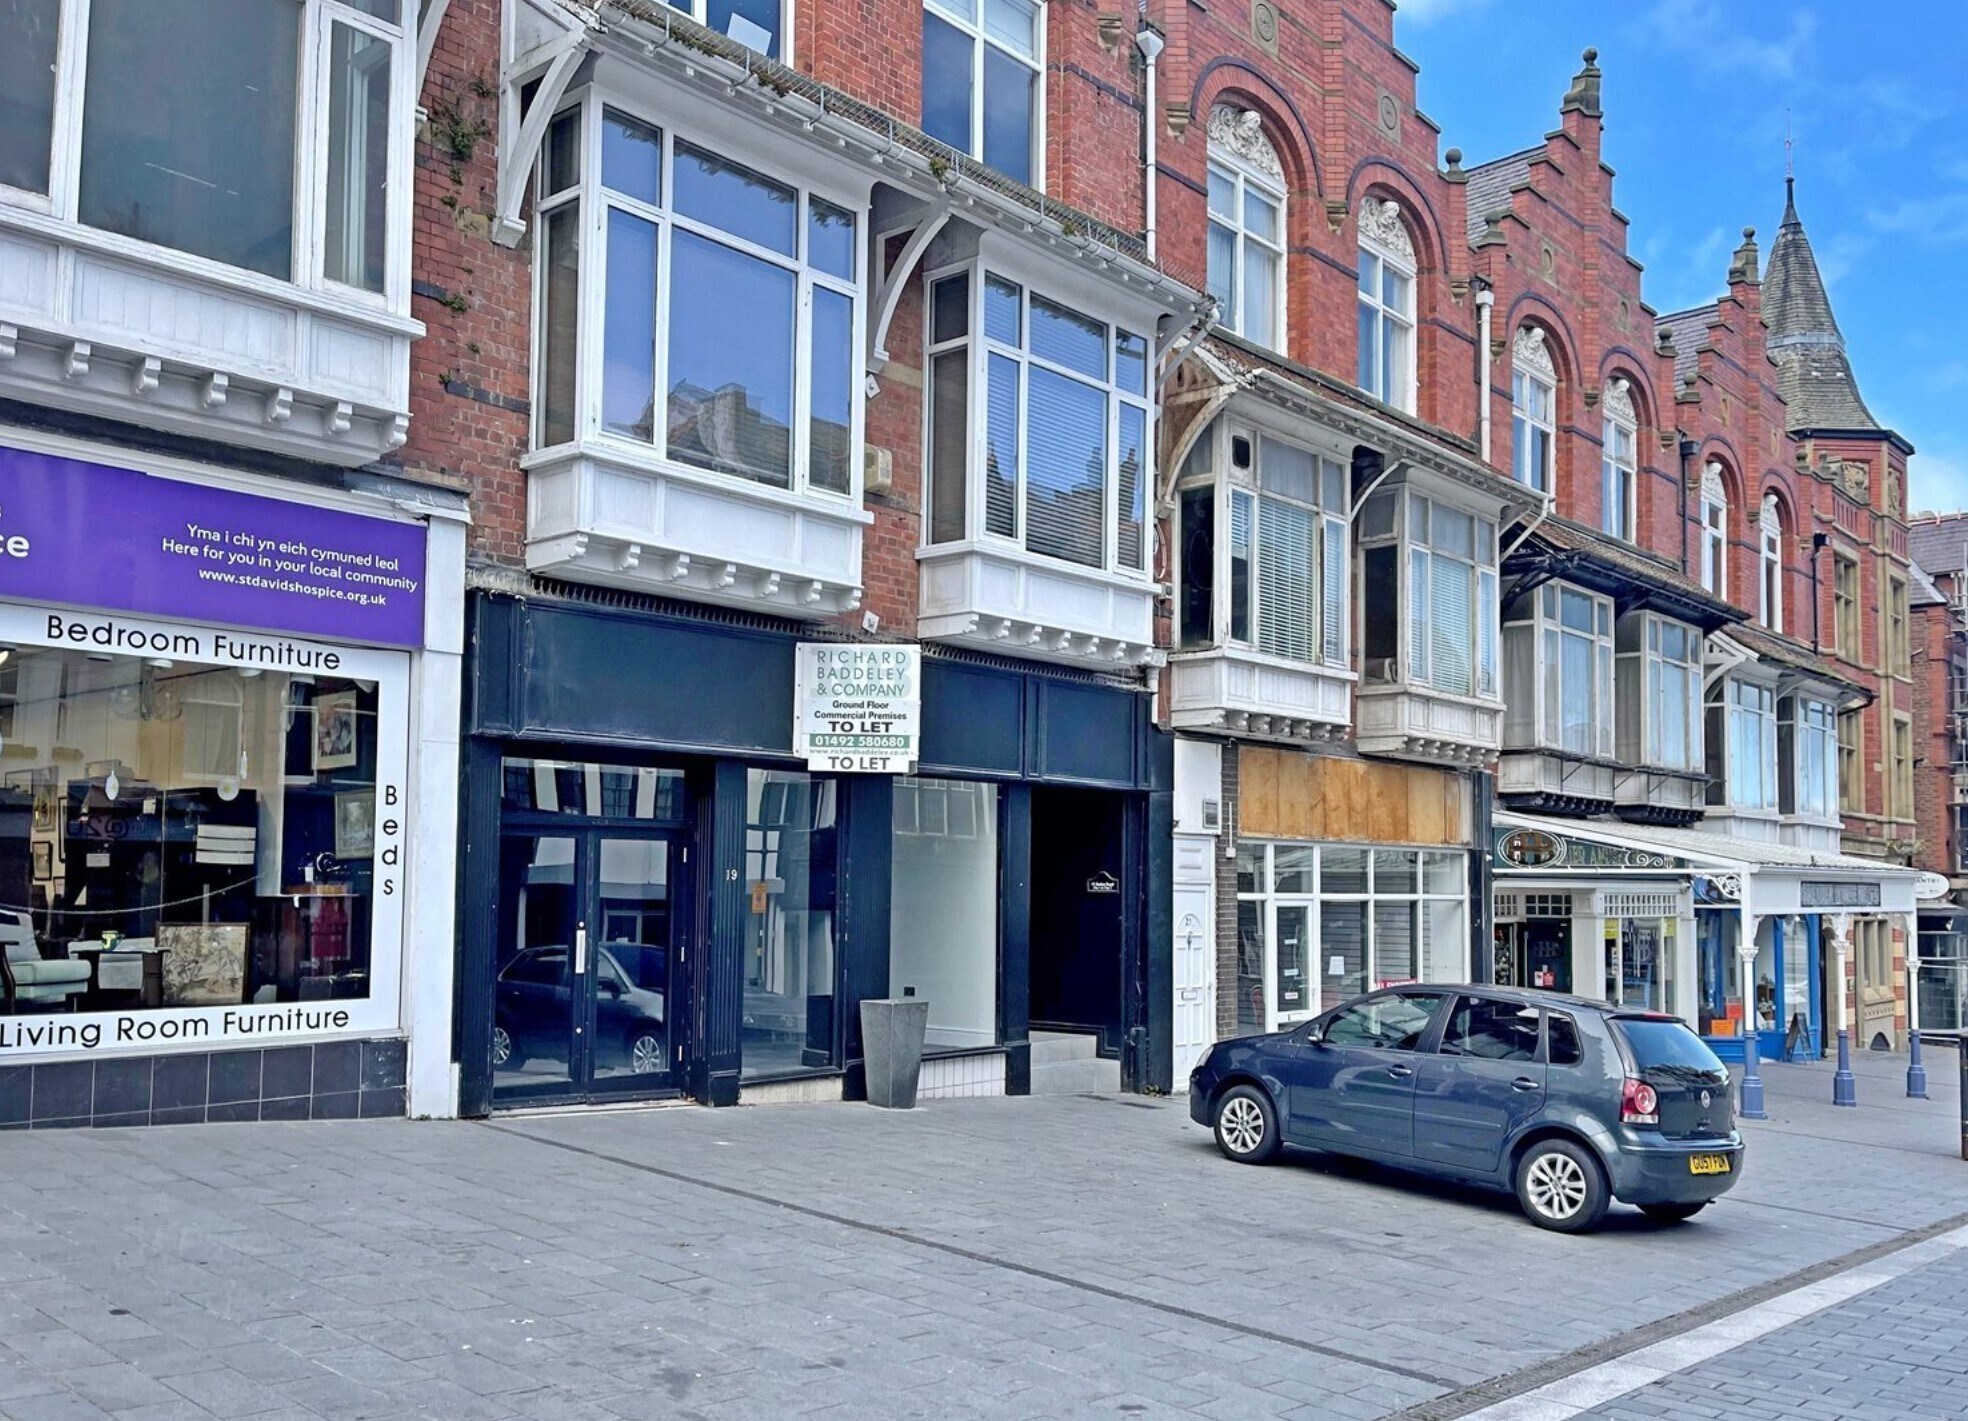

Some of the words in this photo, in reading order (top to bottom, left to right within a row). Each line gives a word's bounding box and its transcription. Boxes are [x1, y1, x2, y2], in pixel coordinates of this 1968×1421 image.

[0, 534, 30, 558] e
[187, 523, 220, 542] Yma
[224, 530, 229, 543] i
[233, 532, 254, 547] chi
[258, 539, 276, 553] yn
[279, 541, 307, 556] eich
[311, 549, 372, 568] cymuned
[375, 557, 399, 572] leol
[162, 538, 199, 556] Here
[203, 544, 224, 560] for
[228, 551, 254, 566] you
[259, 552, 271, 568] in
[275, 559, 306, 574] your
[309, 562, 342, 579] local
[345, 571, 418, 593] community
[199, 570, 387, 606] www.stdavidshospice.org.uk
[46, 615, 200, 655] Bedroom
[213, 635, 341, 670] Furniture
[817, 651, 906, 664] RICHARD
[817, 667, 905, 680] BADDELEY
[816, 683, 827, 695] &
[832, 683, 905, 696] COMPANY
[832, 700, 864, 709] Ground
[867, 700, 889, 709] Floor
[814, 711, 866, 720] Commercial
[868, 712, 907, 720] Premises
[828, 721, 854, 733] TO
[860, 721, 893, 733] LET
[815, 735, 854, 746] 01492
[858, 736, 905, 747] 580680
[828, 756, 854, 769] TO
[860, 757, 891, 770] LET
[382, 785, 399, 895] Beds
[726, 869, 737, 881] 19
[0, 1022, 101, 1049] Living
[117, 1015, 209, 1041] Room
[223, 1007, 350, 1035] Furniture
